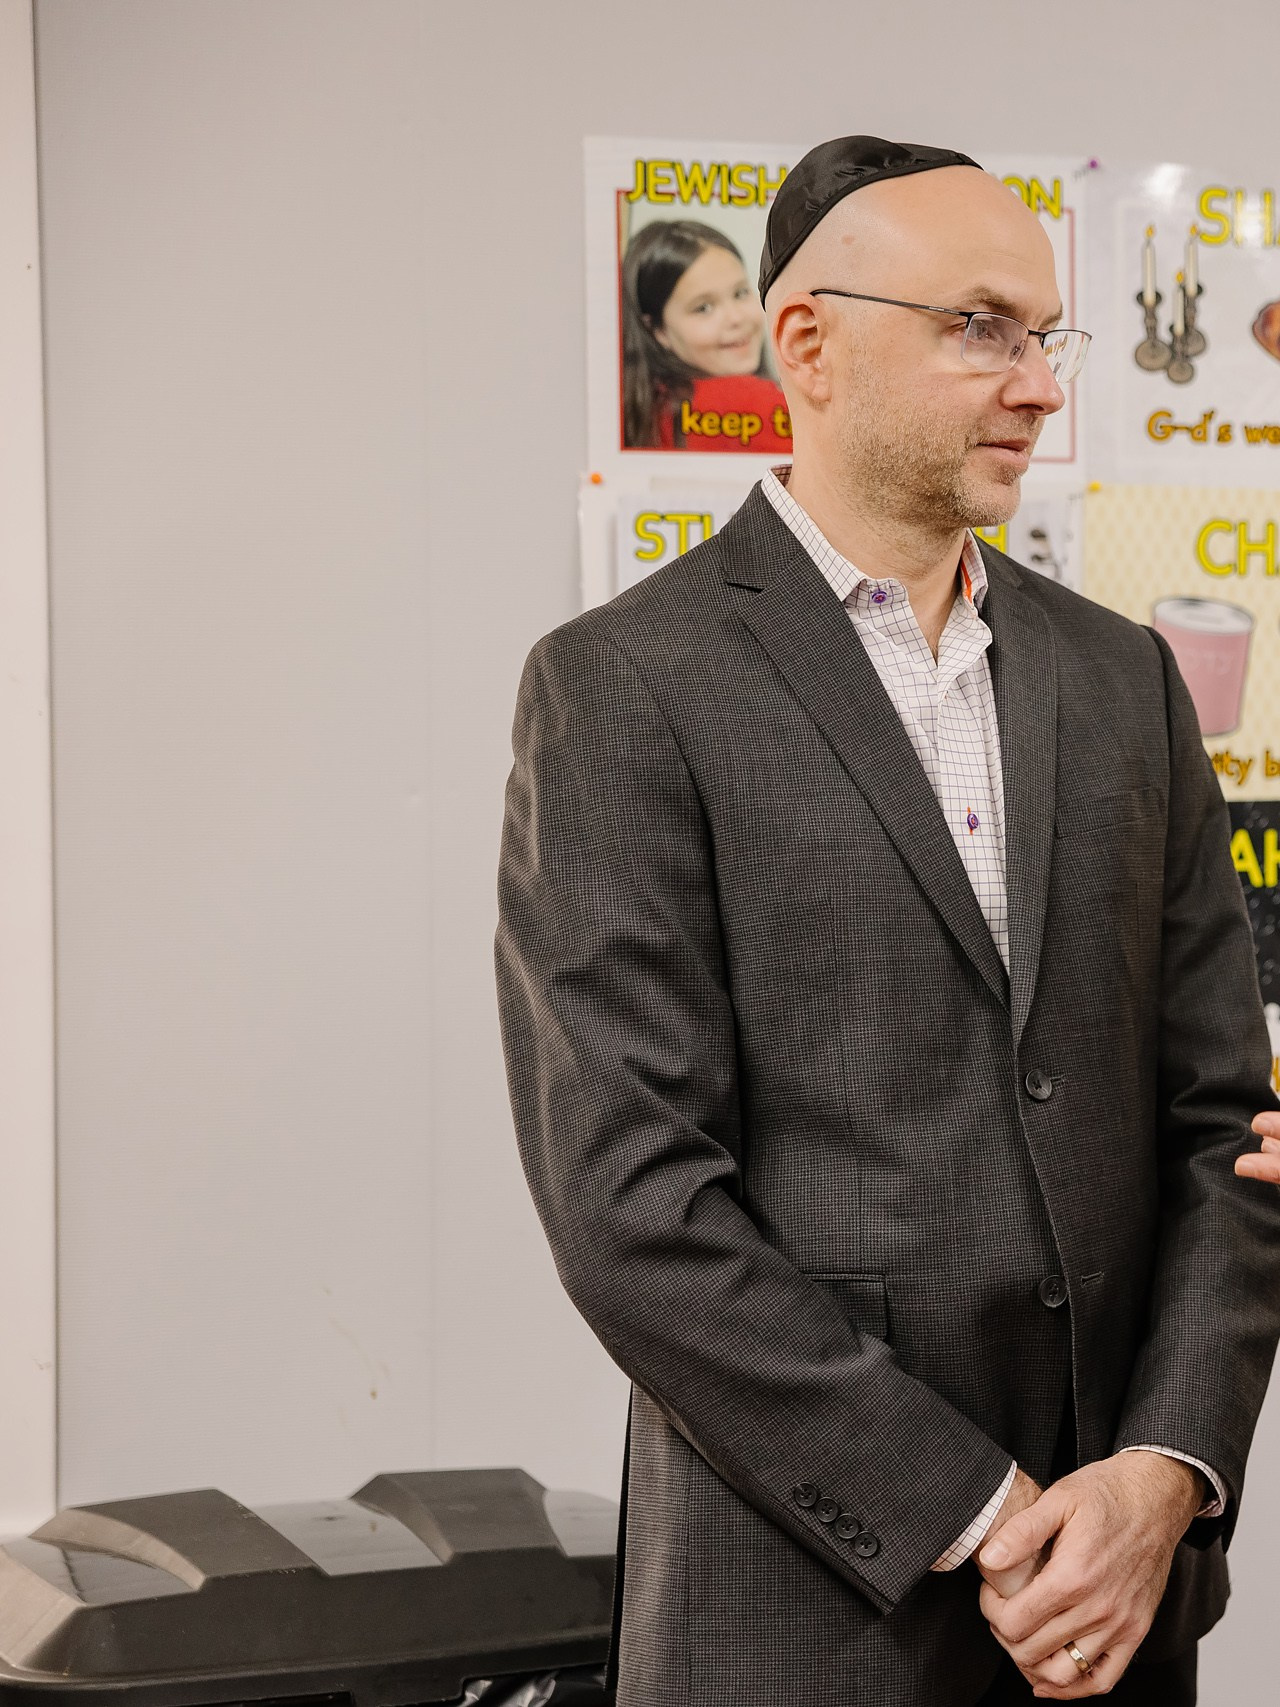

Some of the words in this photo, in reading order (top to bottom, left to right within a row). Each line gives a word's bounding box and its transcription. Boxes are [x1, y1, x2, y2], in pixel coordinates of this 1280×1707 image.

[628, 159, 788, 207] JEWISH
[681, 400, 762, 445] keep
[1147, 409, 1232, 443] G-d's
